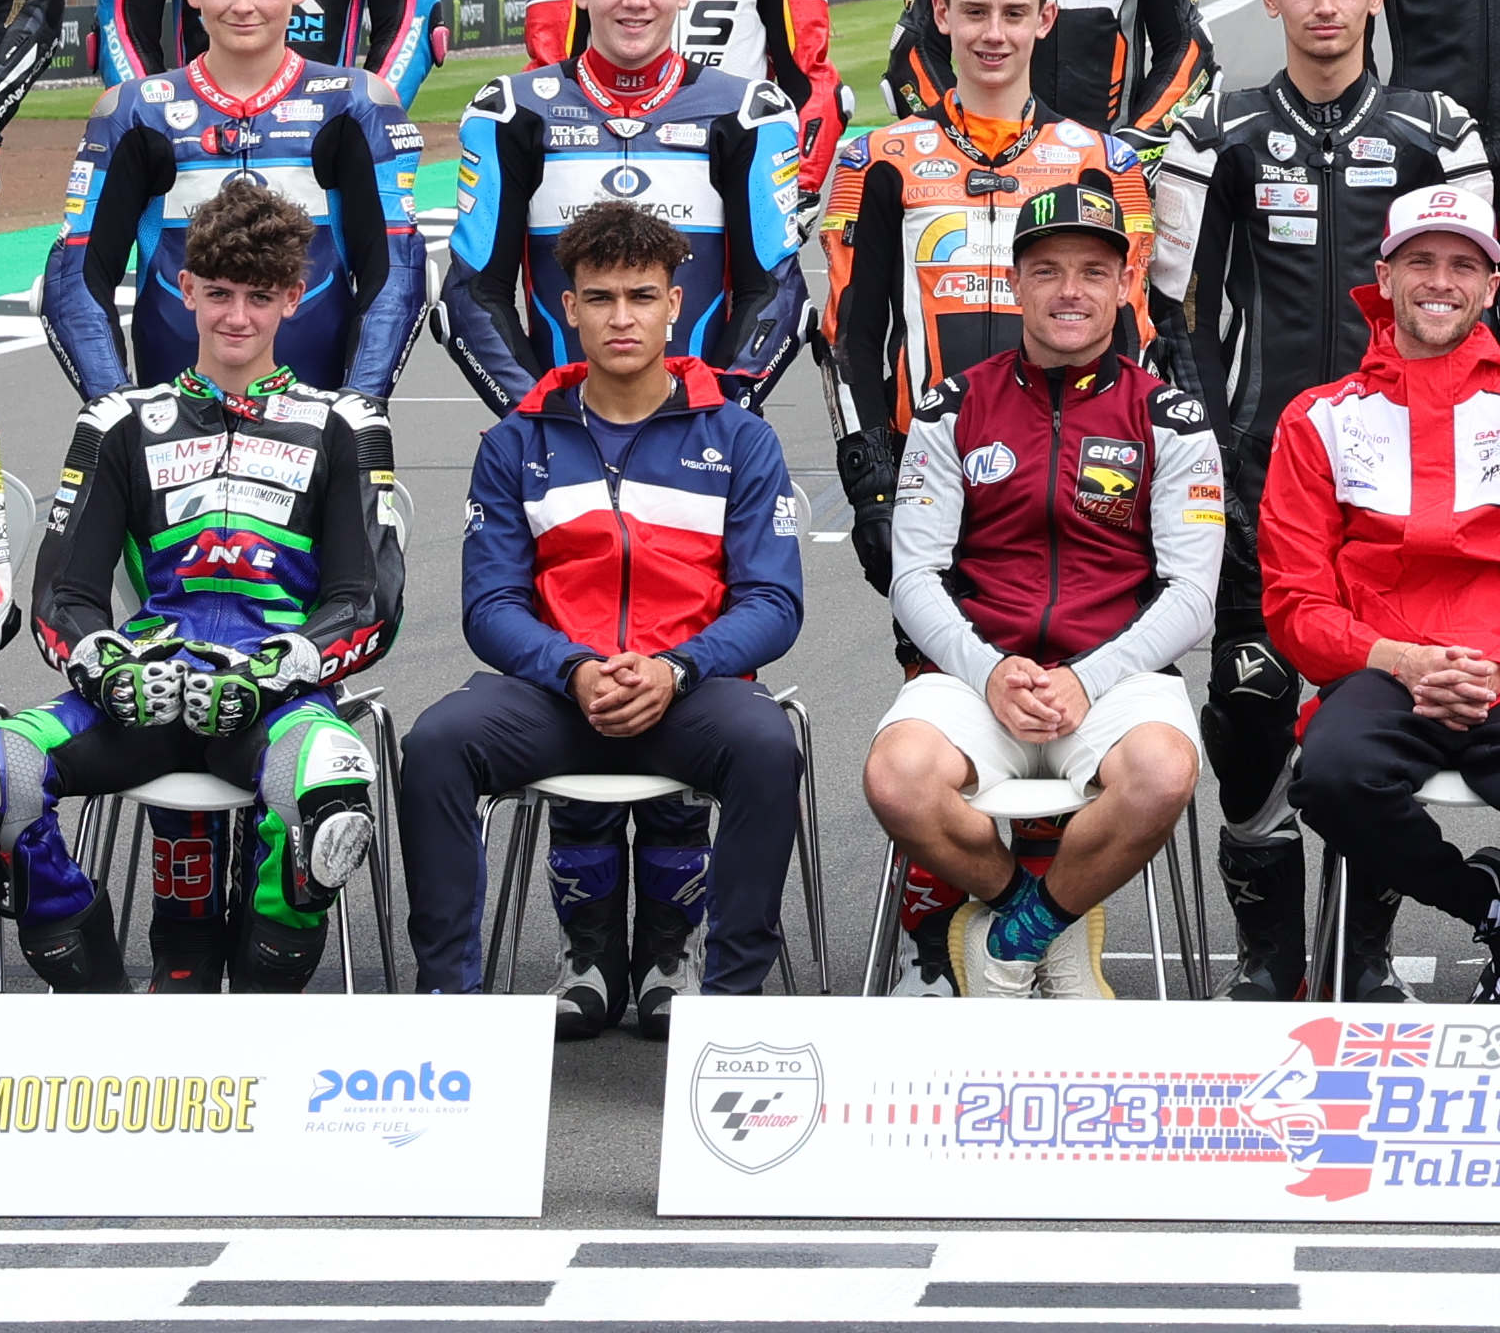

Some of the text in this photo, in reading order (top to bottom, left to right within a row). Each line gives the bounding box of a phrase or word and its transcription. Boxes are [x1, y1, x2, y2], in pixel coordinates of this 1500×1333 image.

[306, 78, 349, 92] R&G
[577, 59, 611, 108] VIRCOS
[641, 57, 683, 111] VIRCOS
[550, 134, 599, 145] AIR BAG
[908, 186, 945, 199] KNOX
[149, 452, 172, 463] THE
[1088, 445, 1118, 460] elf
[716, 1059, 802, 1074] ROAD TO
[308, 1061, 472, 1113] panta
[344, 1106, 387, 1114] MEMBER
[409, 1106, 432, 1114] MOL
[436, 1106, 470, 1114] GROUP
[955, 1082, 1163, 1146] 2023
[305, 1121, 412, 1133] RACING FUEL
